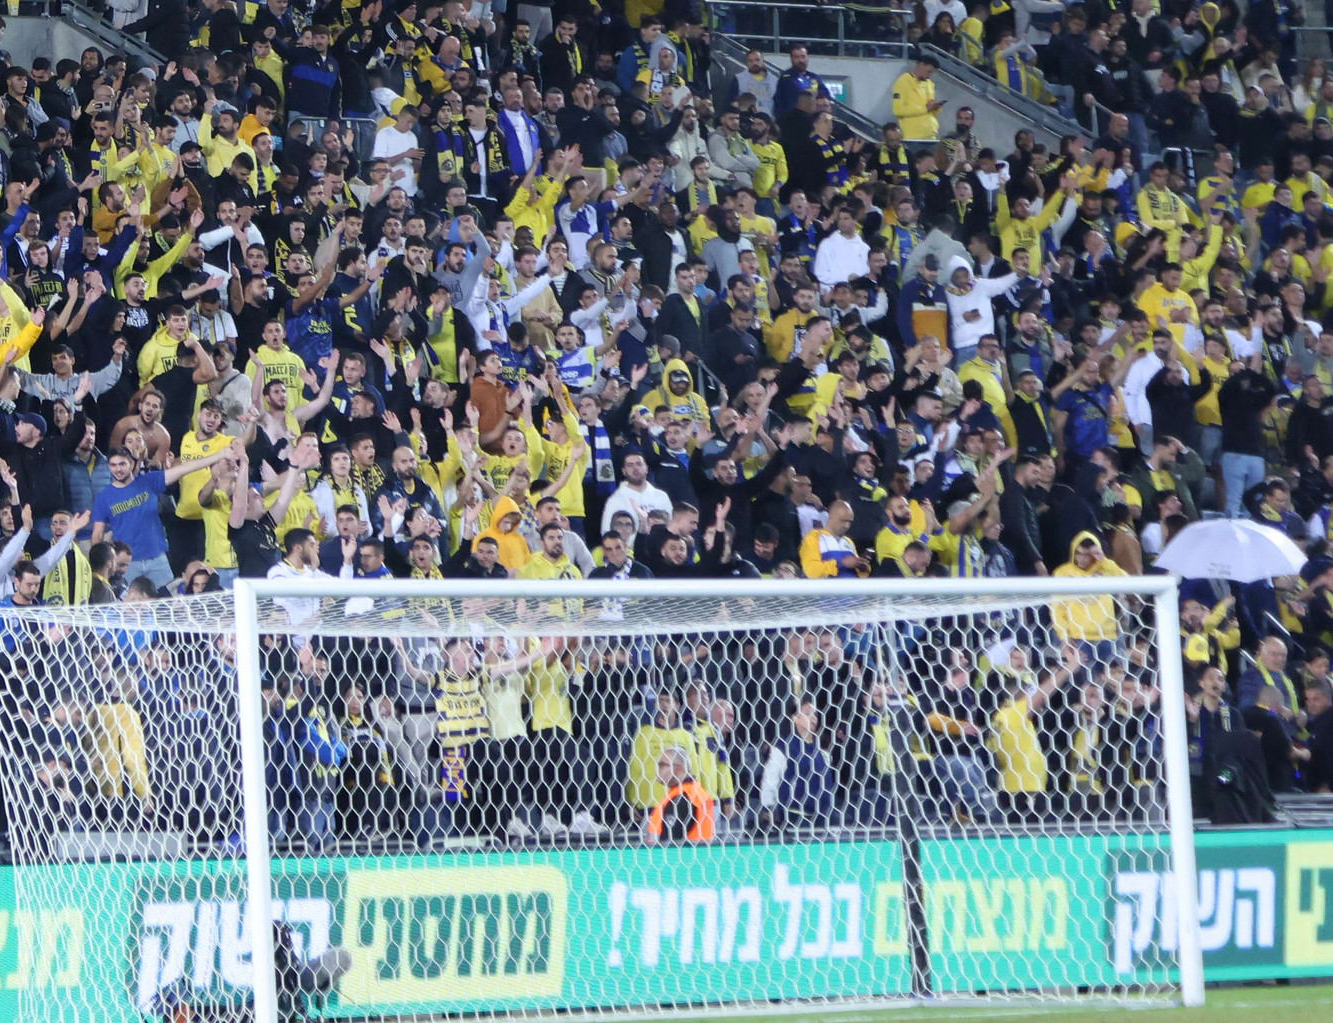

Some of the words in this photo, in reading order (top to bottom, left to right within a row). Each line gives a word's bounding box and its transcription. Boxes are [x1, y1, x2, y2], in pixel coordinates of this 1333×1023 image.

[359, 891, 552, 980] מחסני
[608, 881, 760, 968] מחיר!
[774, 864, 864, 960] בכל
